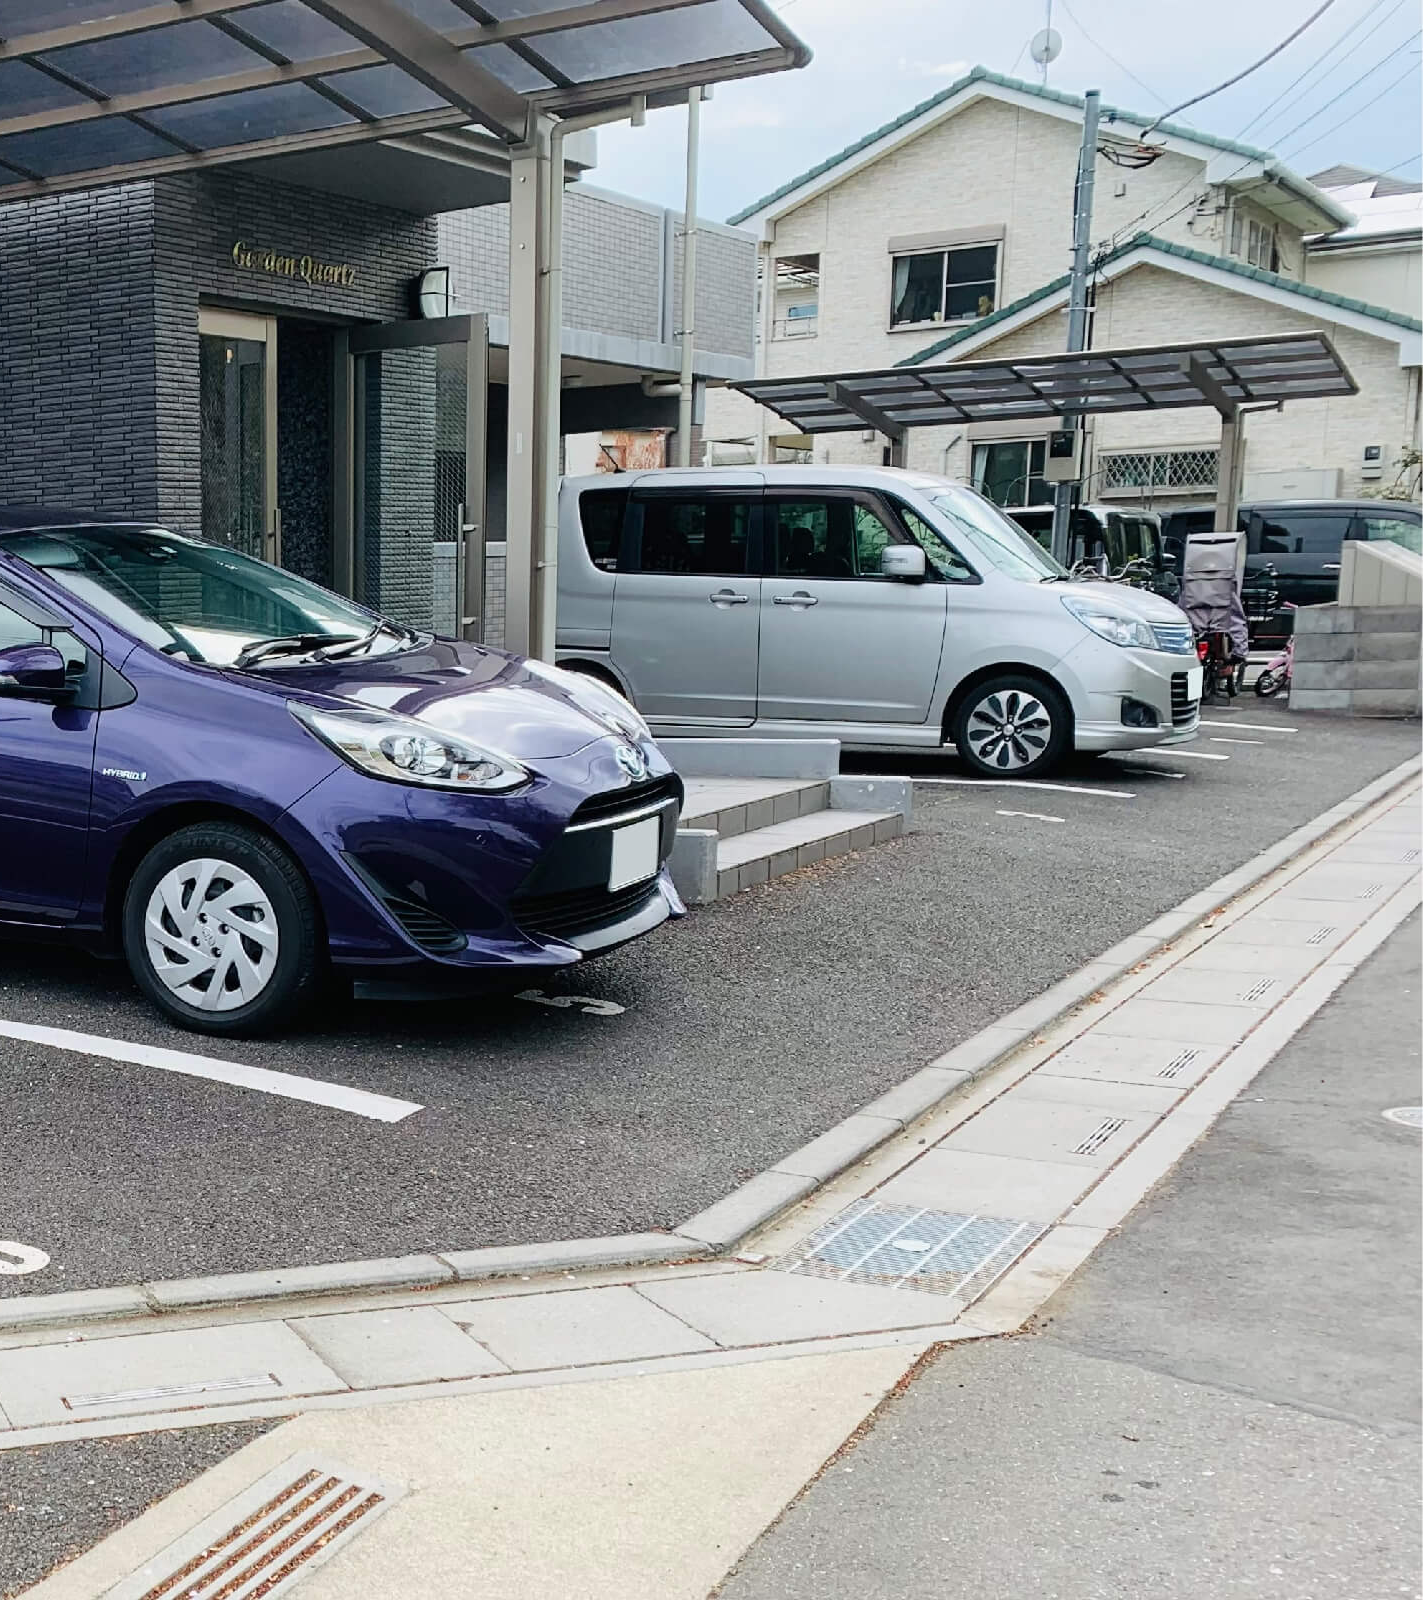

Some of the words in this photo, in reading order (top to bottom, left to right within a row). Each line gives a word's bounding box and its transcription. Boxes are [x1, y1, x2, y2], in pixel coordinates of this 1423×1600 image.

[300, 255, 356, 286] Quartz
[102, 768, 140, 780] HYBRID
[514, 989, 625, 1016] 5
